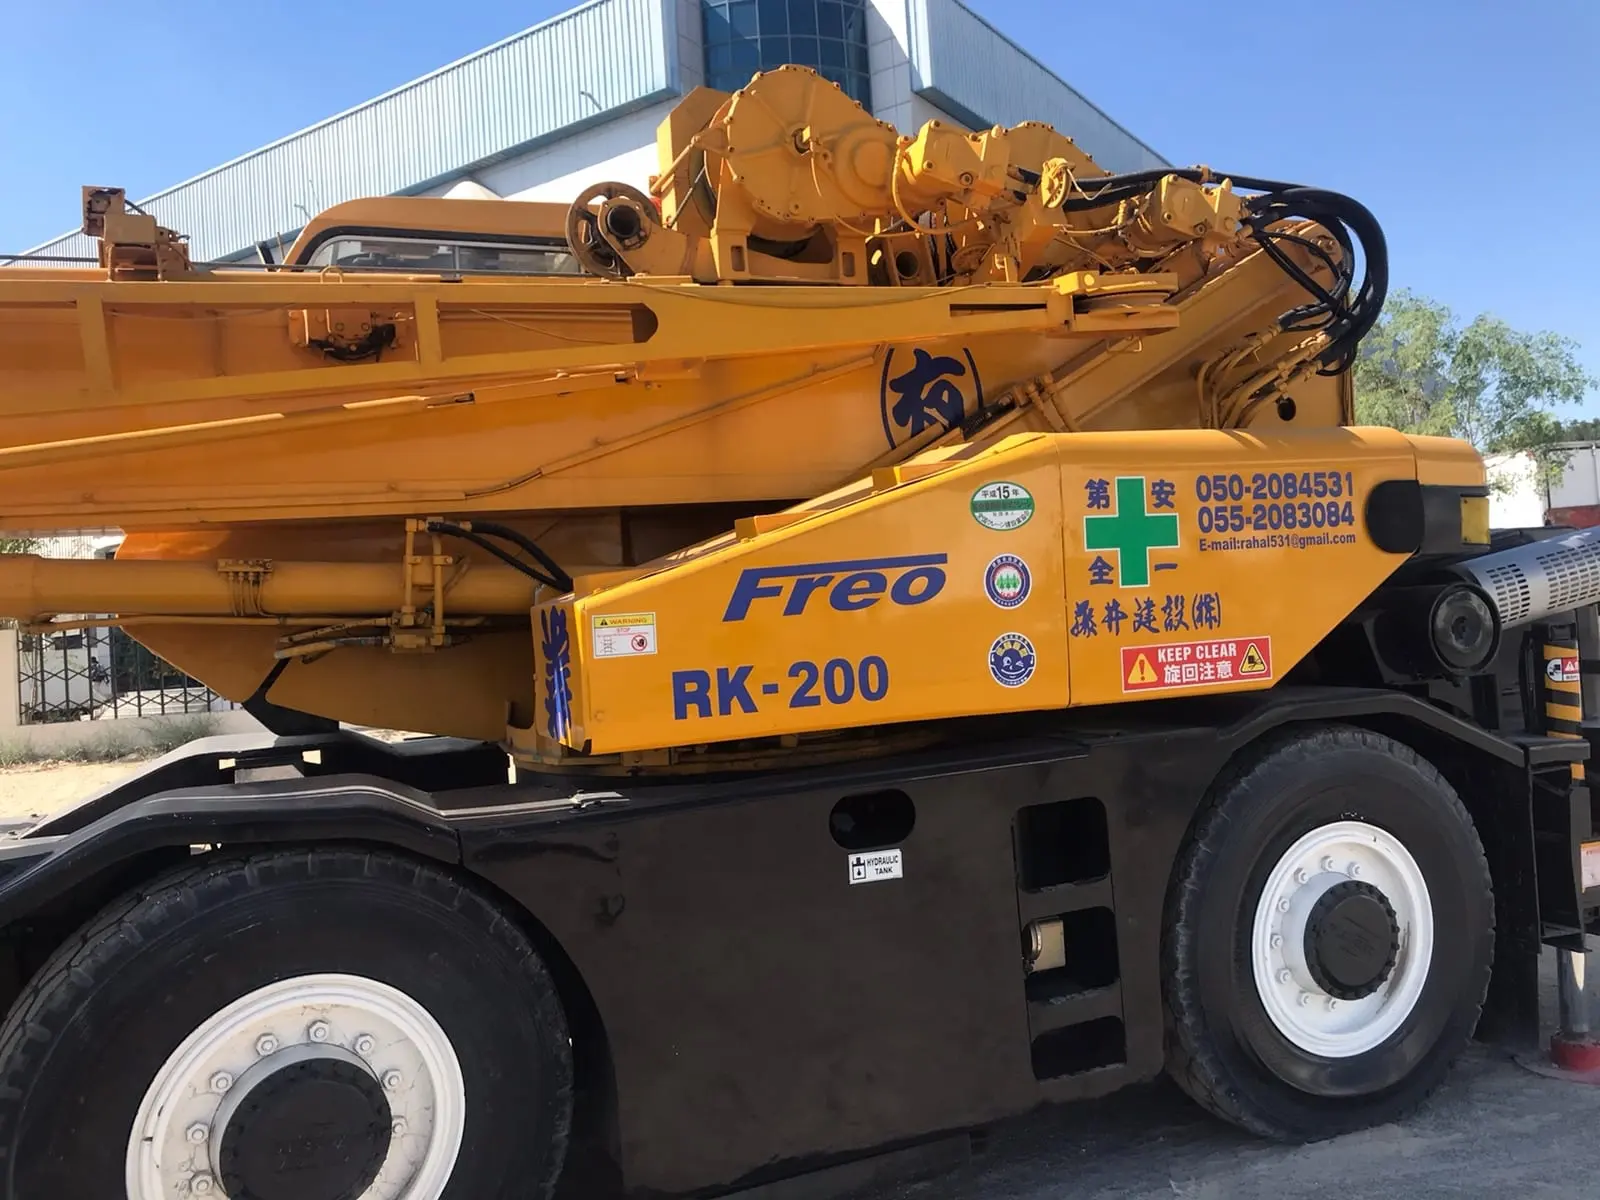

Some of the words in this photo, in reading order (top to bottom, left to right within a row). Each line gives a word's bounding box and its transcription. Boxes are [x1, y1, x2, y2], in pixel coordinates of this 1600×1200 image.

[1084, 478, 1110, 509] 第
[1151, 479, 1176, 508] 安
[1196, 472, 1353, 502] 050-2084531
[1198, 501, 1355, 533] 055-2083084
[1088, 556, 1114, 585] 全
[722, 553, 948, 622] Freo
[1157, 648, 1191, 663] KEEP
[1196, 643, 1237, 659] CLEAR
[1163, 660, 1233, 684] 旋回注意
[672, 655, 889, 720] RK-200
[866, 855, 899, 866] HYDRAULIC
[875, 866, 893, 875] TANK
